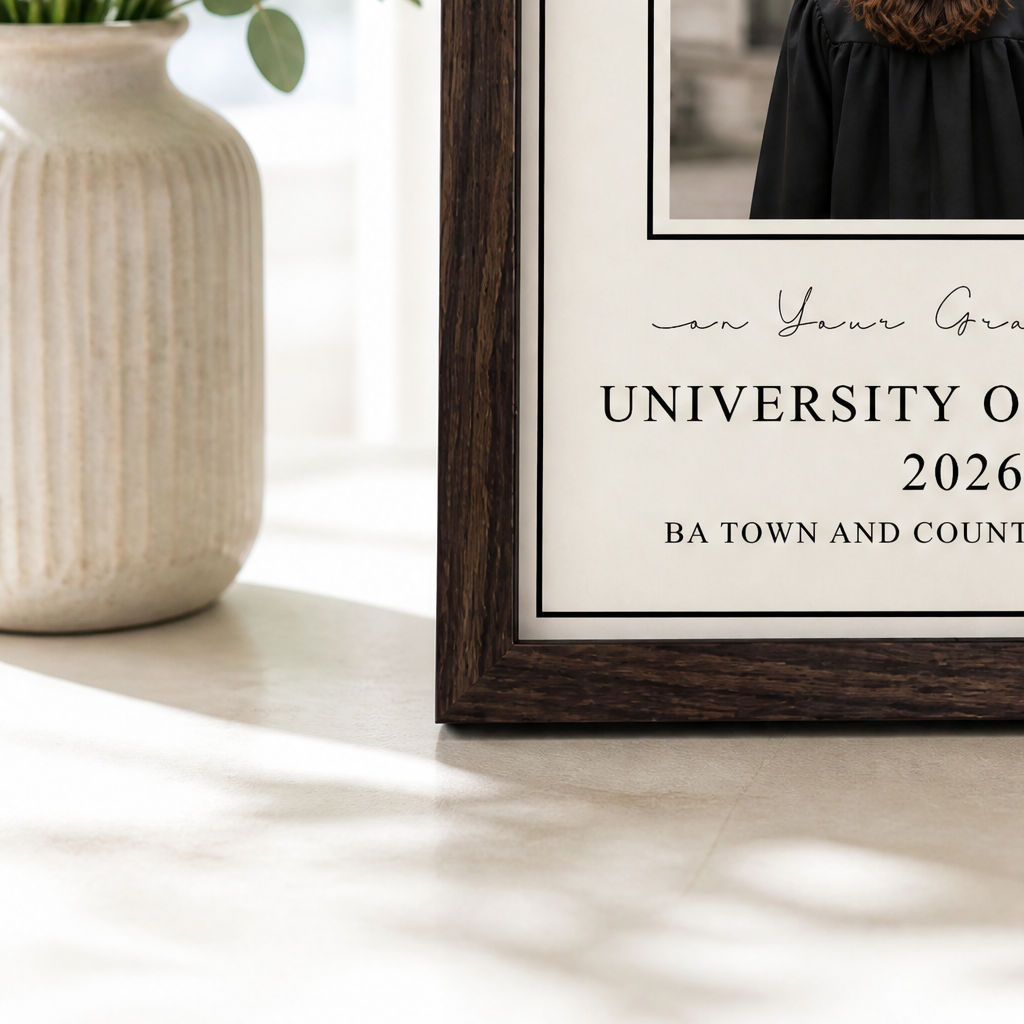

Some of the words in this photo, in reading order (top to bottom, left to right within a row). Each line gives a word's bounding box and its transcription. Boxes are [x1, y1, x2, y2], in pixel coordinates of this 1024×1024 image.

[651, 317, 750, 331] on
[777, 286, 906, 338] Your
[600, 384, 961, 423] UNIVERSITY
[902, 452, 1022, 492] 2026
[664, 521, 709, 544] BA
[721, 521, 818, 544] TOWN
[829, 521, 900, 544] AND
